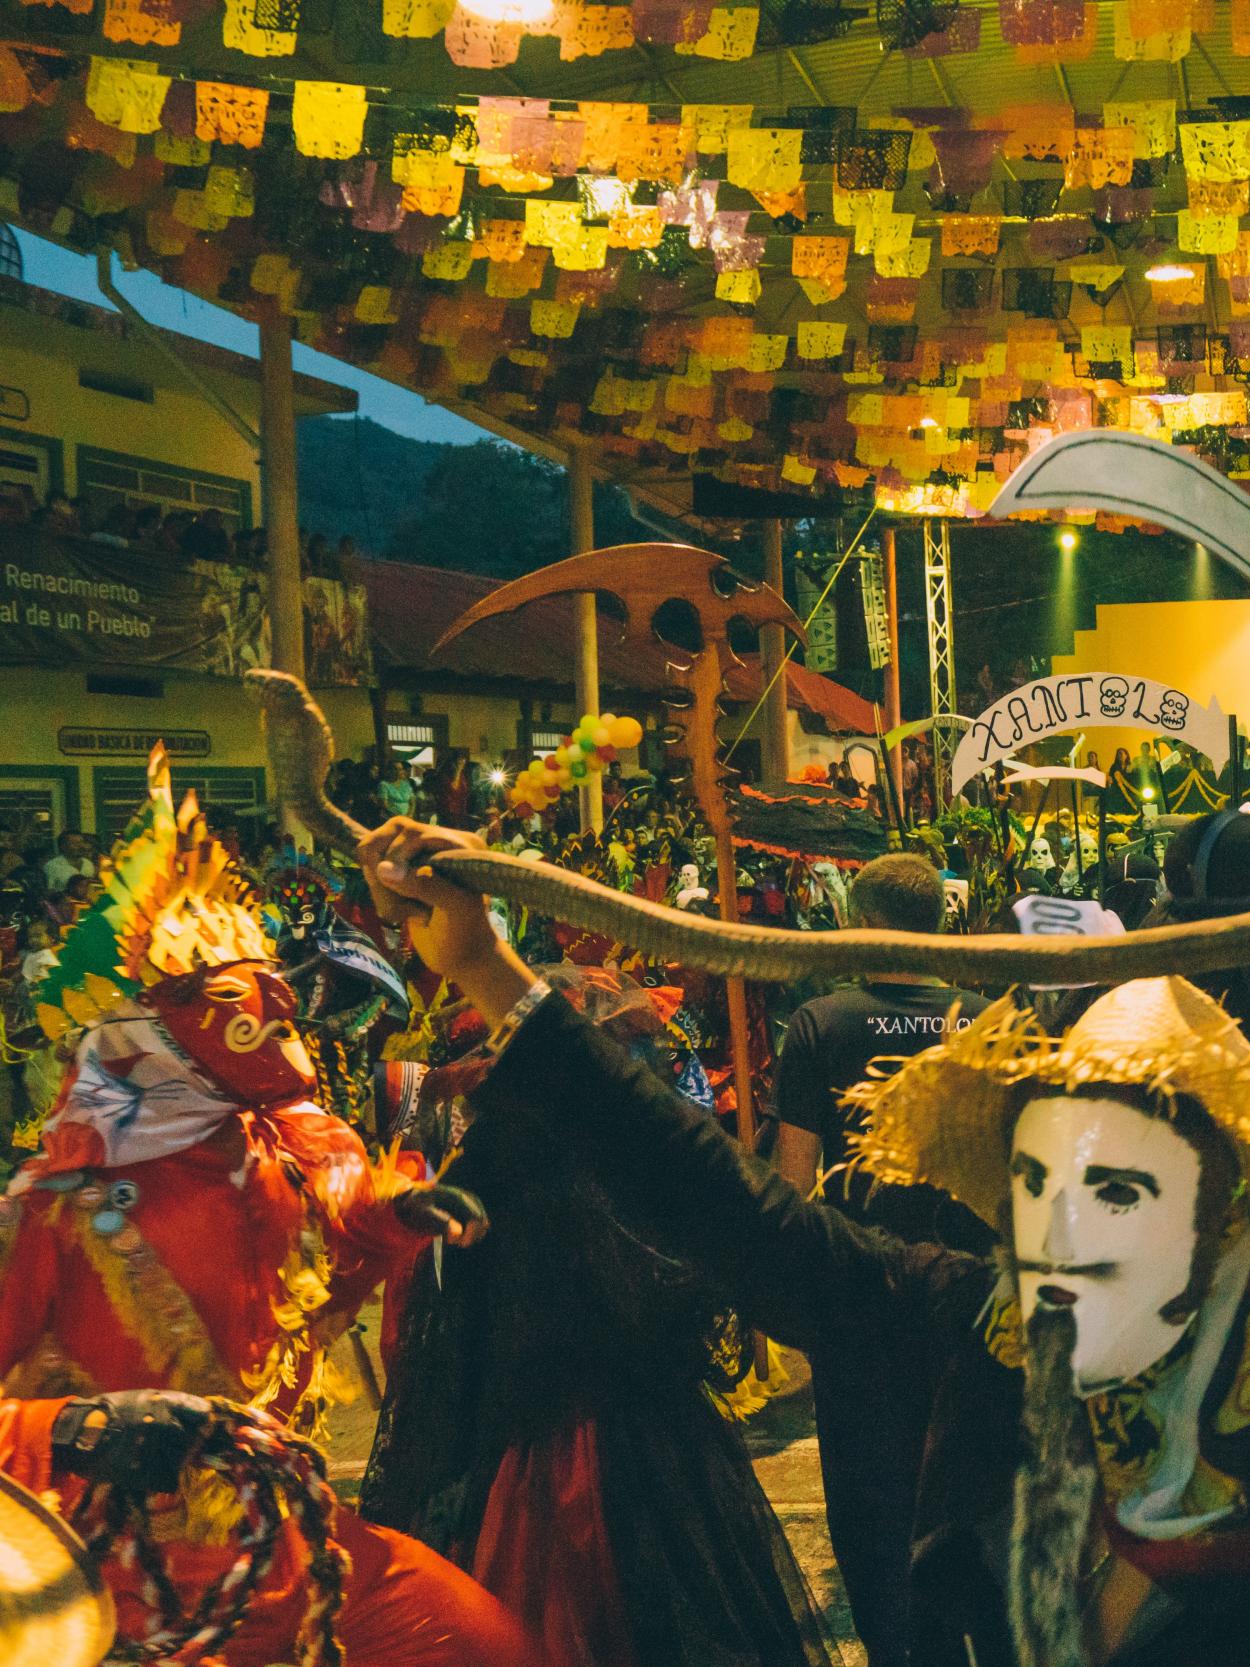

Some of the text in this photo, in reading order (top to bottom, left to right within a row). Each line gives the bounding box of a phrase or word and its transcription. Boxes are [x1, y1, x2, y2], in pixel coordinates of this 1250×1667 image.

[4, 563, 140, 604] Renacimiento
[0, 600, 19, 625] al
[25, 603, 51, 628] de
[57, 610, 82, 631] un
